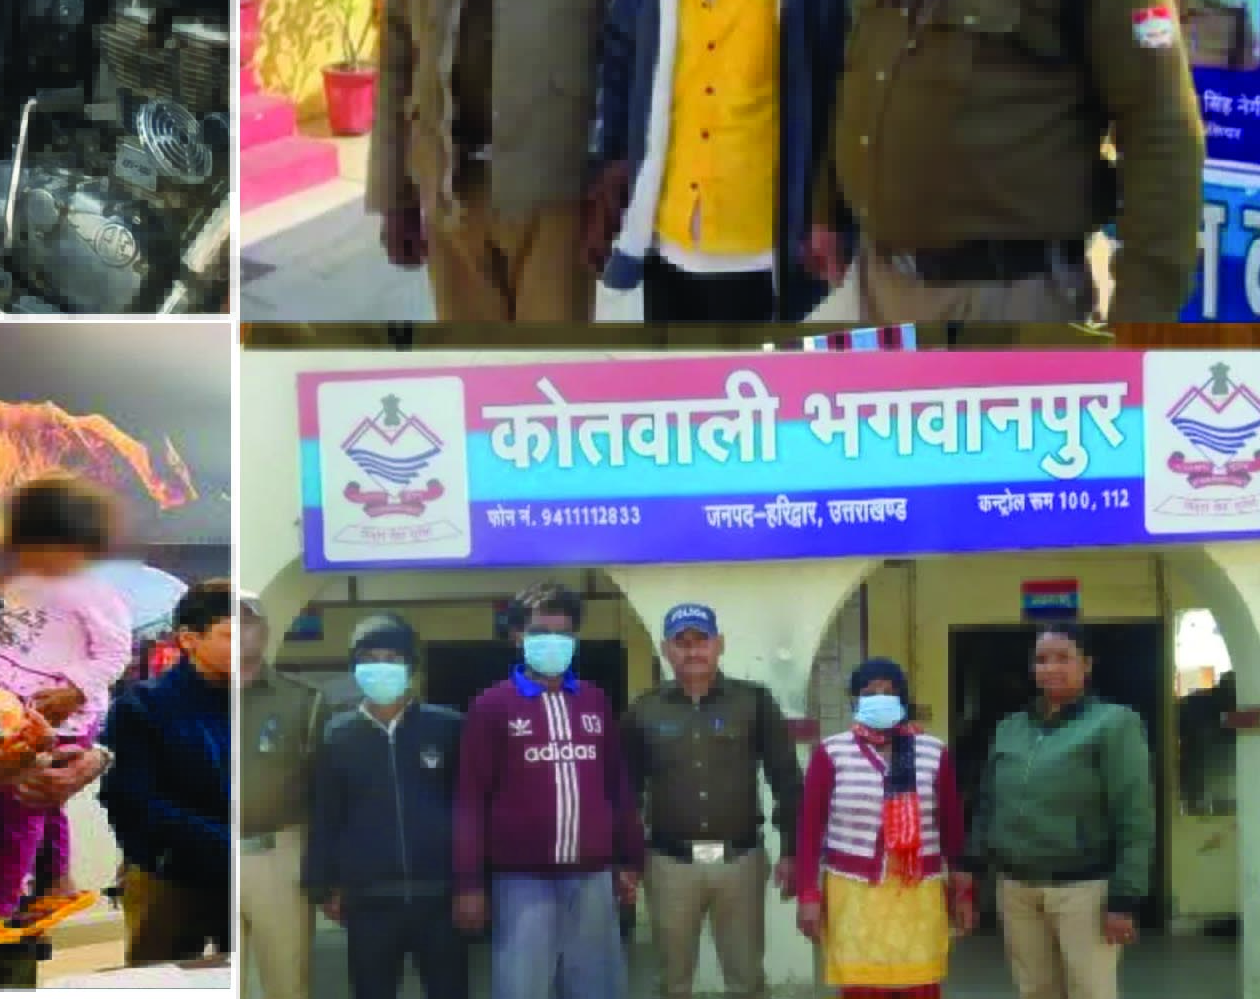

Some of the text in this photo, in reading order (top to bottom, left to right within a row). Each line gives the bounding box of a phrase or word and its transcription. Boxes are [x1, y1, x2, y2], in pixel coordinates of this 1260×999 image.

[482, 370, 1128, 480] कोतवाली भगवानपुर
[1103, 489, 1129, 508] 112
[487, 504, 515, 527] फोन
[541, 506, 641, 526] 9411112833
[524, 742, 597, 762] adidas
